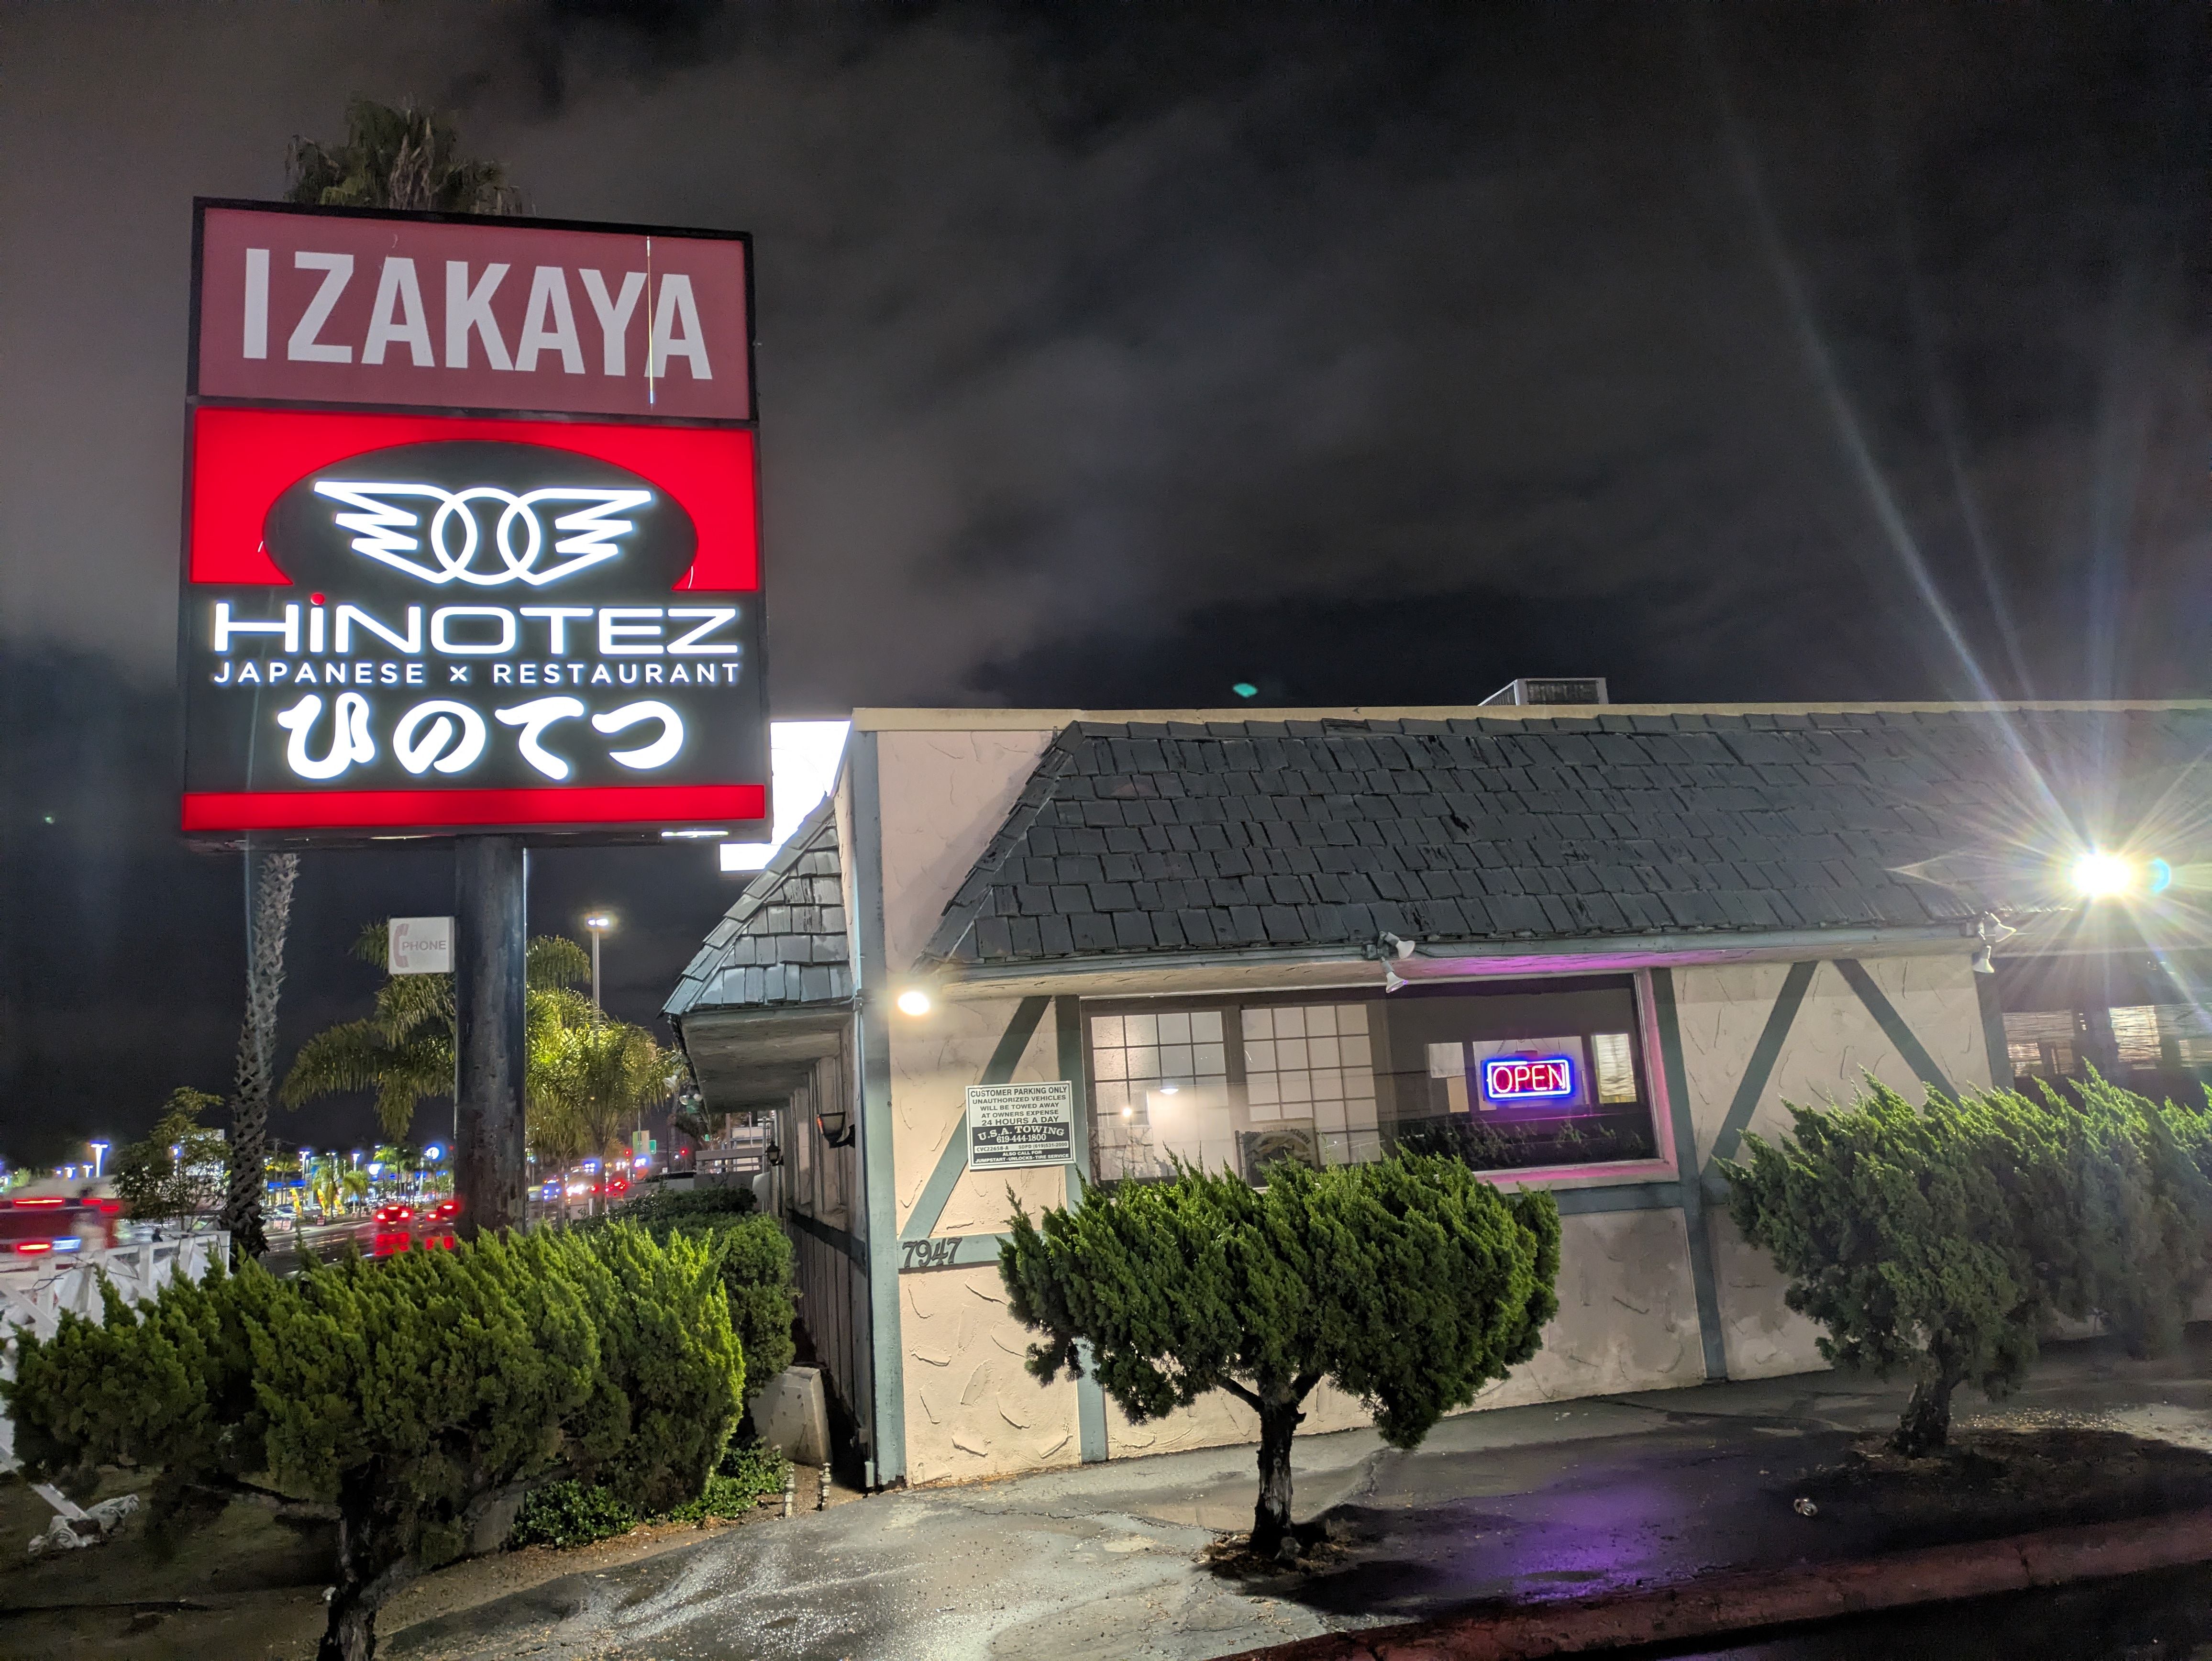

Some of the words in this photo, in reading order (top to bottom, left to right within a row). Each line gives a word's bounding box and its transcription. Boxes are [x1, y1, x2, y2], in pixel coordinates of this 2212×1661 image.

[243, 248, 713, 380] IZAKAYA
[214, 661, 423, 684] JAPANESE
[493, 663, 738, 684] RESTAURANT
[277, 691, 685, 781] ひのてつ
[402, 940, 446, 951] PHONE
[1493, 1063, 1566, 1093] OPEN
[970, 1089, 1012, 1097] CUSTOMER
[1014, 1087, 1046, 1095] PARKING
[995, 1117, 1029, 1125] HOURS
[977, 1127, 1013, 1141] U.S.A.
[1014, 1125, 1064, 1136] TOWING
[996, 1133, 1047, 1143] 619-444-1800
[902, 1237, 962, 1268] 7947
